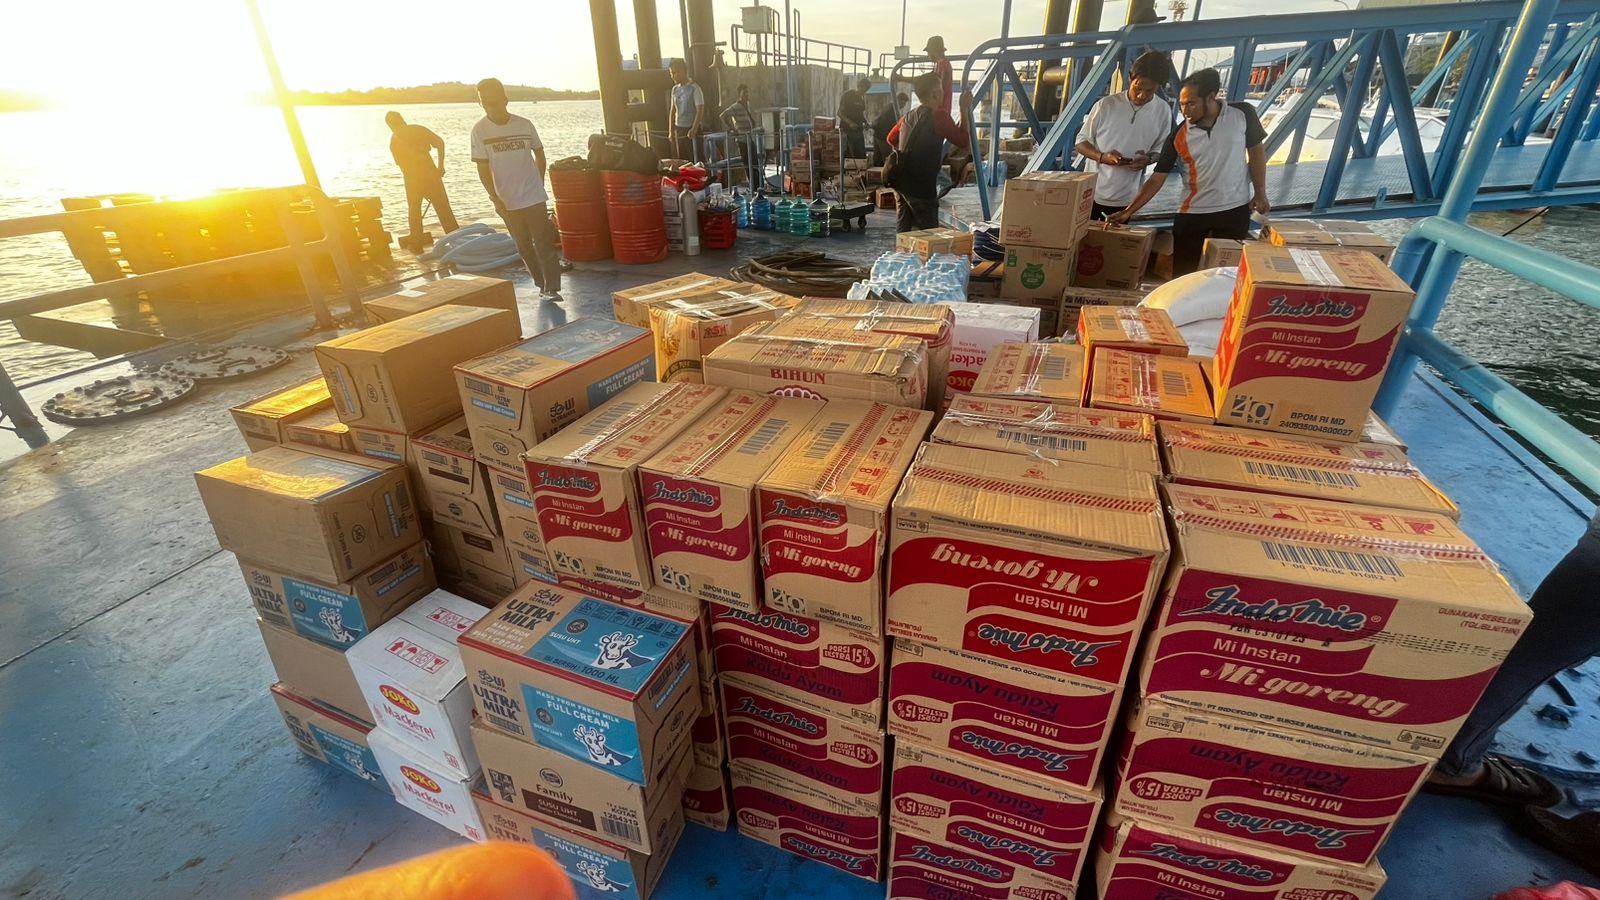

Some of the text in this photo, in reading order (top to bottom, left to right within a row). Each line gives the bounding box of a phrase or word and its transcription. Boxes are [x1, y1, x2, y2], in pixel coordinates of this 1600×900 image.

[1252, 294, 1356, 318] Indomie
[1272, 331, 1321, 344] Mi Instan
[951, 354, 986, 366] acker
[1255, 350, 1367, 376] Mi goreng
[606, 368, 645, 395] FULL CREAM
[947, 376, 978, 387] OKO
[1231, 399, 1273, 420] 40
[1291, 412, 1318, 422] BPOM
[534, 470, 596, 491] Indomie
[648, 480, 714, 506] Indomie
[562, 501, 585, 511] Instan
[765, 498, 839, 520] Indomie
[550, 514, 621, 537] Mi goreng
[666, 512, 701, 526] Mi Instan
[661, 527, 738, 556] Mi goreng
[784, 529, 822, 544] Mi Instan
[775, 546, 862, 578] Mi goreng
[931, 543, 1099, 595] Mi goreng
[250, 586, 284, 605] ULTRA
[300, 590, 343, 608] FULL CREAM
[703, 584, 721, 593] BPOM
[731, 590, 741, 599] MD
[258, 597, 283, 614] MILK
[506, 599, 556, 622] ULTRA
[820, 607, 841, 616] BPOM
[851, 614, 863, 622] MD
[1015, 592, 1089, 619] Mi Instan
[1177, 584, 1368, 631] Indomie
[1438, 608, 1520, 625] GUNAKAN SEBELUM
[498, 611, 541, 630] MILK
[550, 632, 581, 645] SUSU UHT
[740, 635, 788, 659] Mi Instan
[829, 645, 850, 653] PORSI
[978, 623, 1121, 667] Indomie
[824, 650, 851, 661] EKSTRA
[851, 649, 871, 665] 15%
[1213, 638, 1301, 665] Mi Instan
[553, 658, 620, 684] BERSIH 1000 ML
[746, 655, 791, 682] Kaldu
[794, 671, 843, 698] Ayam
[382, 686, 418, 713] JOKO
[473, 684, 521, 712] ULTRA
[931, 669, 1061, 715] Kaldu Ayam
[1200, 662, 1409, 718] Mi goreng
[483, 700, 518, 721] MILK
[536, 690, 620, 723] MADE FROM FRESH MILK
[547, 700, 609, 729] FULL CREAM
[733, 697, 817, 733] Indomie
[897, 703, 918, 719] 15%
[917, 713, 942, 723] PORSI
[918, 706, 948, 717] EKSTRA
[383, 703, 435, 740] Mackerel
[993, 712, 1059, 738] Mi Instan
[1217, 706, 1258, 718] INDOFOOD
[1277, 716, 1305, 727] SUKSES
[1305, 723, 1341, 735] MAKMUR
[753, 727, 798, 750] Mi Instan
[835, 742, 855, 750] PORSI
[831, 746, 856, 758] EKSTRA
[856, 745, 874, 762] 15%
[962, 731, 1089, 770] Indomie
[402, 767, 439, 792] JOKO
[802, 764, 849, 787] Ayam
[1189, 747, 1351, 789] Kaldu Ayam
[536, 784, 573, 803] Family
[929, 773, 983, 796] Ayam
[1136, 780, 1162, 796] 15%
[1161, 792, 1192, 800] PORSI
[1163, 785, 1200, 796] EKSTRA
[402, 779, 457, 816] Mackerel
[538, 799, 578, 816] SUSU UHT
[917, 804, 946, 814] EKSTRA
[987, 790, 1046, 816] Kaldu
[1262, 788, 1343, 812] Mi Instan
[611, 808, 638, 819] KOTAK
[917, 810, 940, 818] PORSI
[986, 811, 1046, 836] Mi Instan
[805, 825, 850, 844] Mi Instan
[1215, 809, 1376, 849] Indomie
[554, 841, 609, 866] FULL CREAM
[958, 826, 1073, 866] Indomie
[900, 845, 1002, 879] Indomie
[1128, 842, 1273, 882] Indomie
[923, 871, 937, 879] Mi
[939, 875, 974, 891] Instan
[1021, 886, 1044, 894] PORSI
[1157, 871, 1176, 882] Mi
[1178, 878, 1225, 898] Instan
[1294, 889, 1325, 898] PORSI
